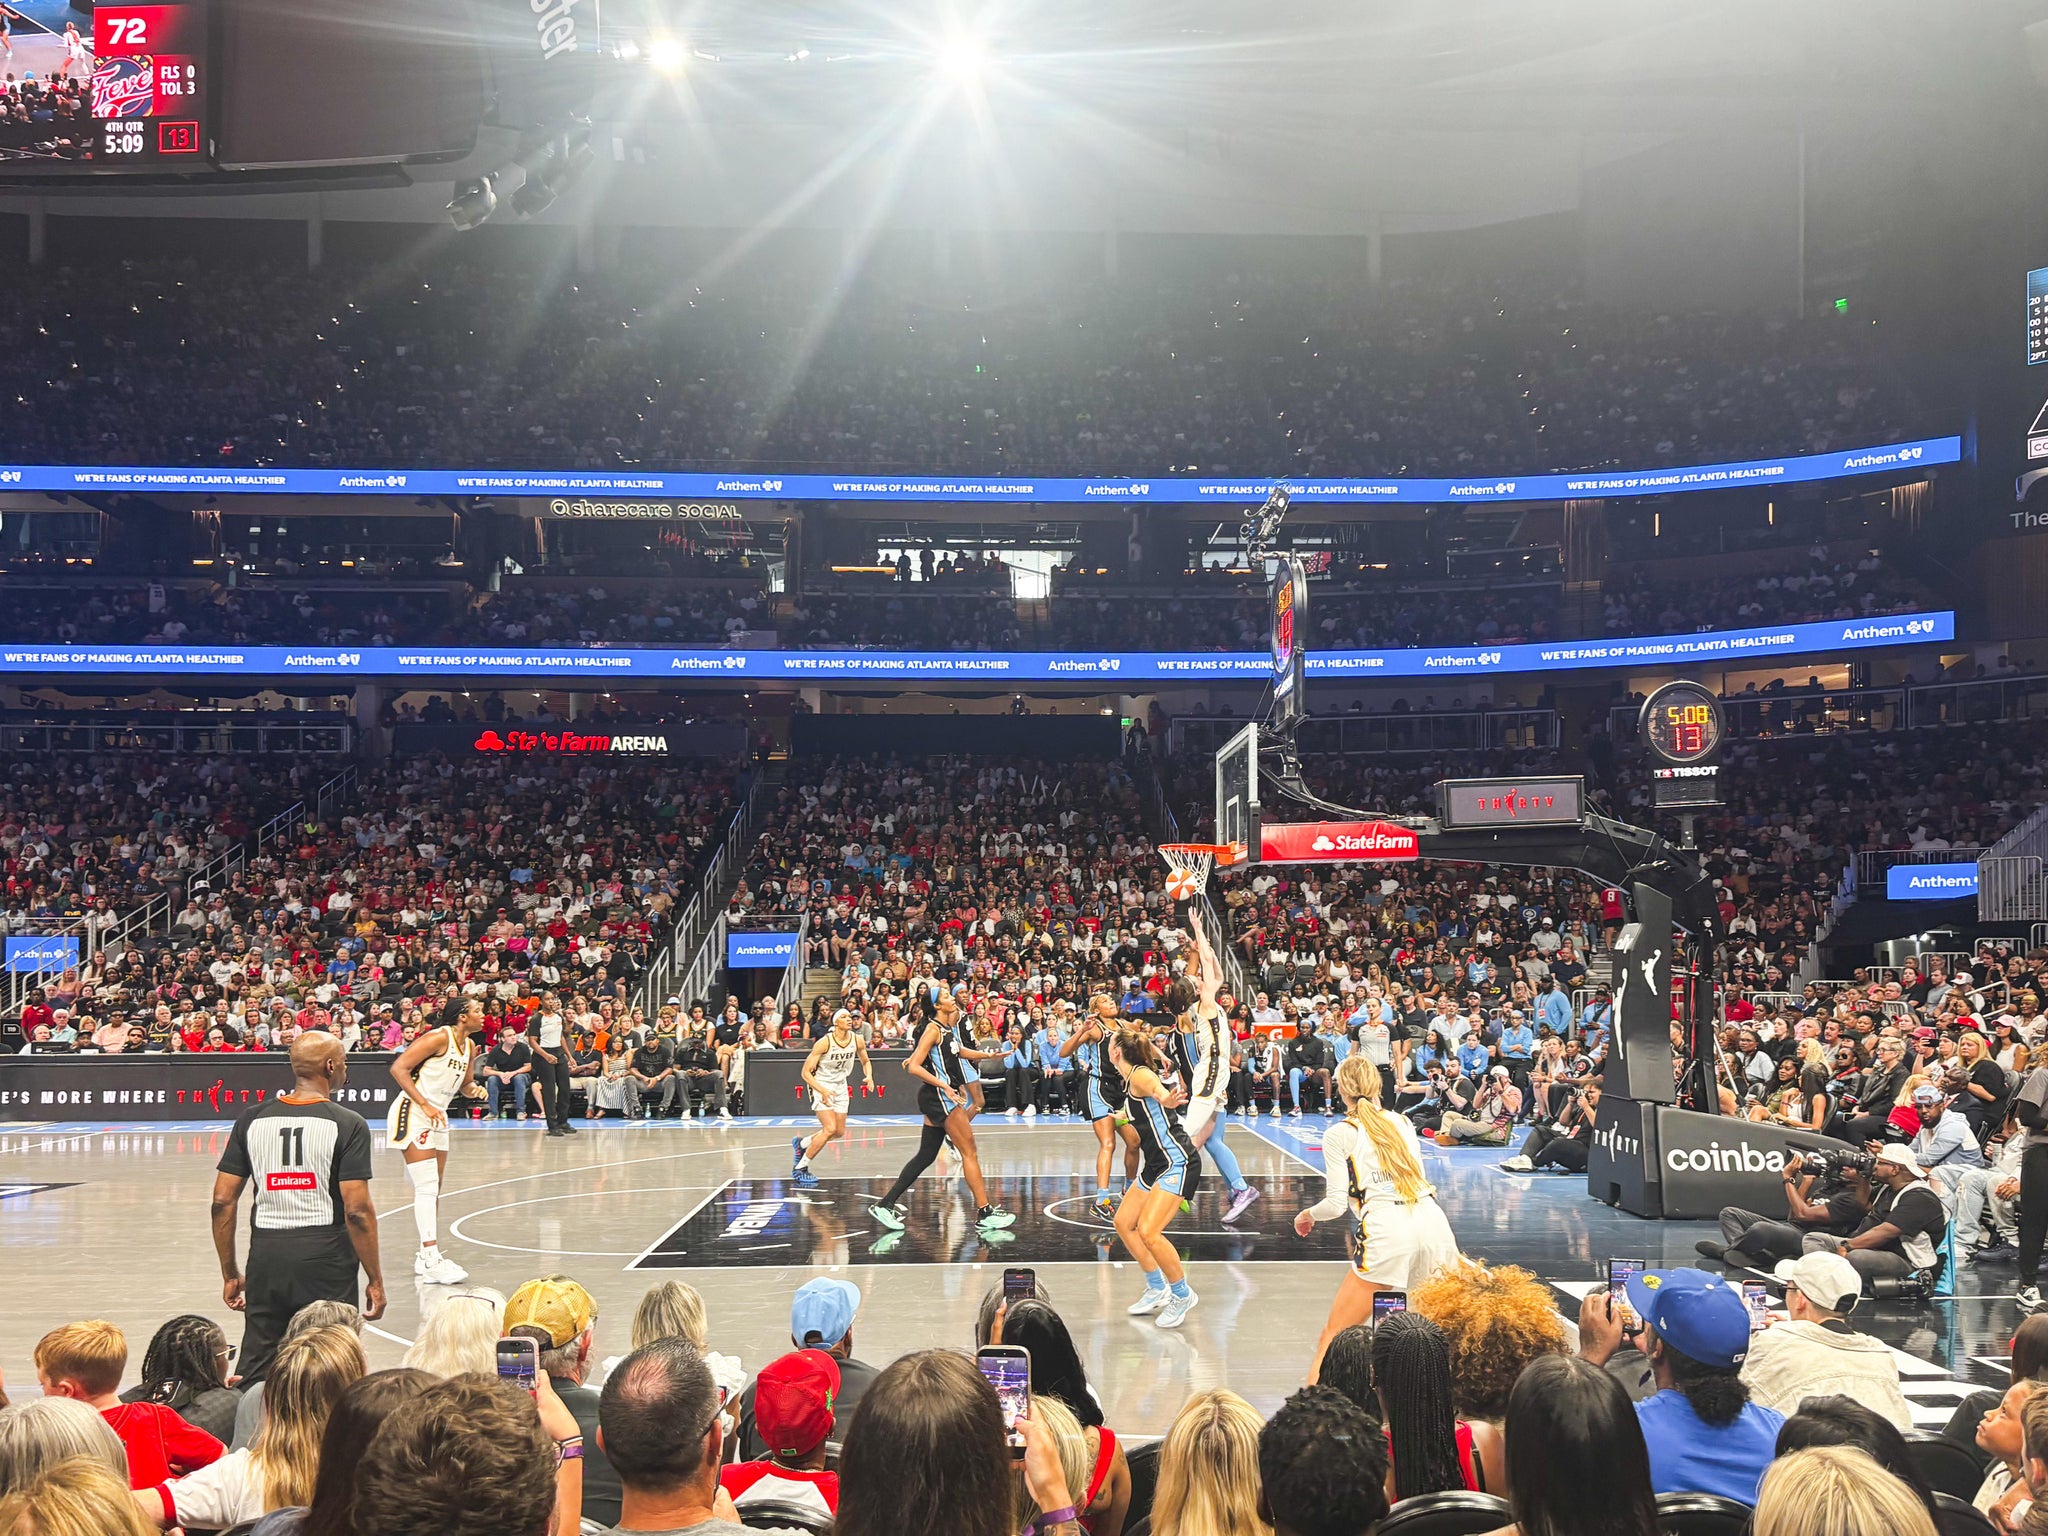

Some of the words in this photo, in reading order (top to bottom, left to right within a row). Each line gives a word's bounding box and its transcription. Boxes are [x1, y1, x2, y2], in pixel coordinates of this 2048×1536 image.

[107, 17, 147, 45] 72
[160, 65, 180, 79] FLS
[186, 64, 195, 79] 0
[160, 81, 183, 96] TOL
[186, 81, 196, 95] 3
[104, 121, 124, 132] 4TH
[125, 121, 144, 132] QTR
[167, 128, 190, 148] 13
[104, 135, 144, 154] 5:09
[2029, 296, 2041, 306] 20
[1844, 454, 1896, 468] Anthem
[74, 474, 106, 482] WE'RE
[106, 474, 132, 483] FANS
[133, 474, 148, 483] OF
[148, 475, 188, 483] MAKING
[189, 475, 233, 484] ATLANTA
[234, 476, 286, 485] HEALTHIER
[339, 476, 385, 487] Anthem
[458, 478, 488, 487] WE'RE
[488, 478, 513, 487] FANS
[514, 478, 528, 487] OF
[529, 479, 568, 487] MAKING
[568, 479, 612, 488] ATLANTA
[613, 479, 663, 488] HEALTHIER
[1567, 481, 1597, 490] WE'RE
[1598, 479, 1624, 489] FANS
[1624, 479, 1638, 488] OF
[1640, 475, 1680, 486] MAKING
[1682, 471, 1728, 483] ATLANTA
[1728, 466, 1784, 479] HEALTHIER
[716, 481, 762, 491] Anthem
[832, 483, 862, 492] WE'RE
[864, 483, 887, 492] FANS
[888, 484, 902, 492] OF
[902, 484, 940, 493] MAKING
[942, 484, 983, 493] ATLANTA
[984, 485, 1034, 494] HEALTHIER
[1084, 485, 1128, 495] Anthem
[1199, 486, 1228, 494] WE'RE
[1229, 486, 1253, 494] FANS
[1254, 486, 1268, 494] OF
[1306, 486, 1348, 494] ATLANTA
[1349, 486, 1398, 494] HEALTHIER
[1449, 486, 1494, 495] Anthem
[573, 500, 671, 519] sharecare
[679, 504, 741, 520] SOCIAL
[1842, 625, 1902, 640] Anthem
[1541, 650, 1576, 660] WE'RE
[1578, 648, 1608, 658] FANS
[1609, 647, 1625, 657] OF
[1626, 644, 1674, 656] MAKING
[1676, 640, 1729, 653] ATLANTA
[1730, 634, 1795, 648] HEALTHIER
[4, 653, 40, 662] WE'RE
[40, 653, 70, 663] FANS
[70, 653, 86, 663] OF
[88, 654, 132, 663] MAKING
[134, 654, 184, 663] ATLANTA
[186, 654, 244, 664] HEALTHIER
[284, 654, 336, 666] Anthem
[398, 656, 432, 665] WE'RE
[434, 656, 462, 665] FANS
[462, 656, 478, 665] OF
[479, 656, 522, 666] MAKING
[524, 657, 574, 666] ATLANTA
[574, 657, 631, 667] HEALTHIER
[672, 657, 722, 669] Anthem
[784, 659, 816, 669] WE'RE
[818, 659, 845, 668] FANS
[846, 660, 861, 669] OF
[862, 660, 904, 669] MAKING
[906, 660, 954, 669] ATLANTA
[954, 660, 1010, 669] HEALTHIER
[1328, 658, 1384, 668] HEALTHIER
[1424, 655, 1476, 667] Anthem
[1048, 660, 1097, 671] Anthem
[1157, 661, 1189, 670] WE'RE
[1190, 660, 1217, 670] FANS
[1218, 660, 1233, 669] OF
[1668, 705, 1709, 725] 5:08
[611, 736, 668, 751] ARENA
[1675, 726, 1702, 751] 13
[1672, 766, 1719, 777] TISSOT
[1909, 876, 1973, 888] Anthem
[736, 946, 774, 955] Anthem
[451, 1073, 461, 1089] 7
[40, 1090, 93, 1104] MORE
[103, 1090, 166, 1104] WHERE
[337, 1088, 387, 1102] FROM
[279, 1126, 304, 1167] 11
[270, 1176, 312, 1187] Emirates
